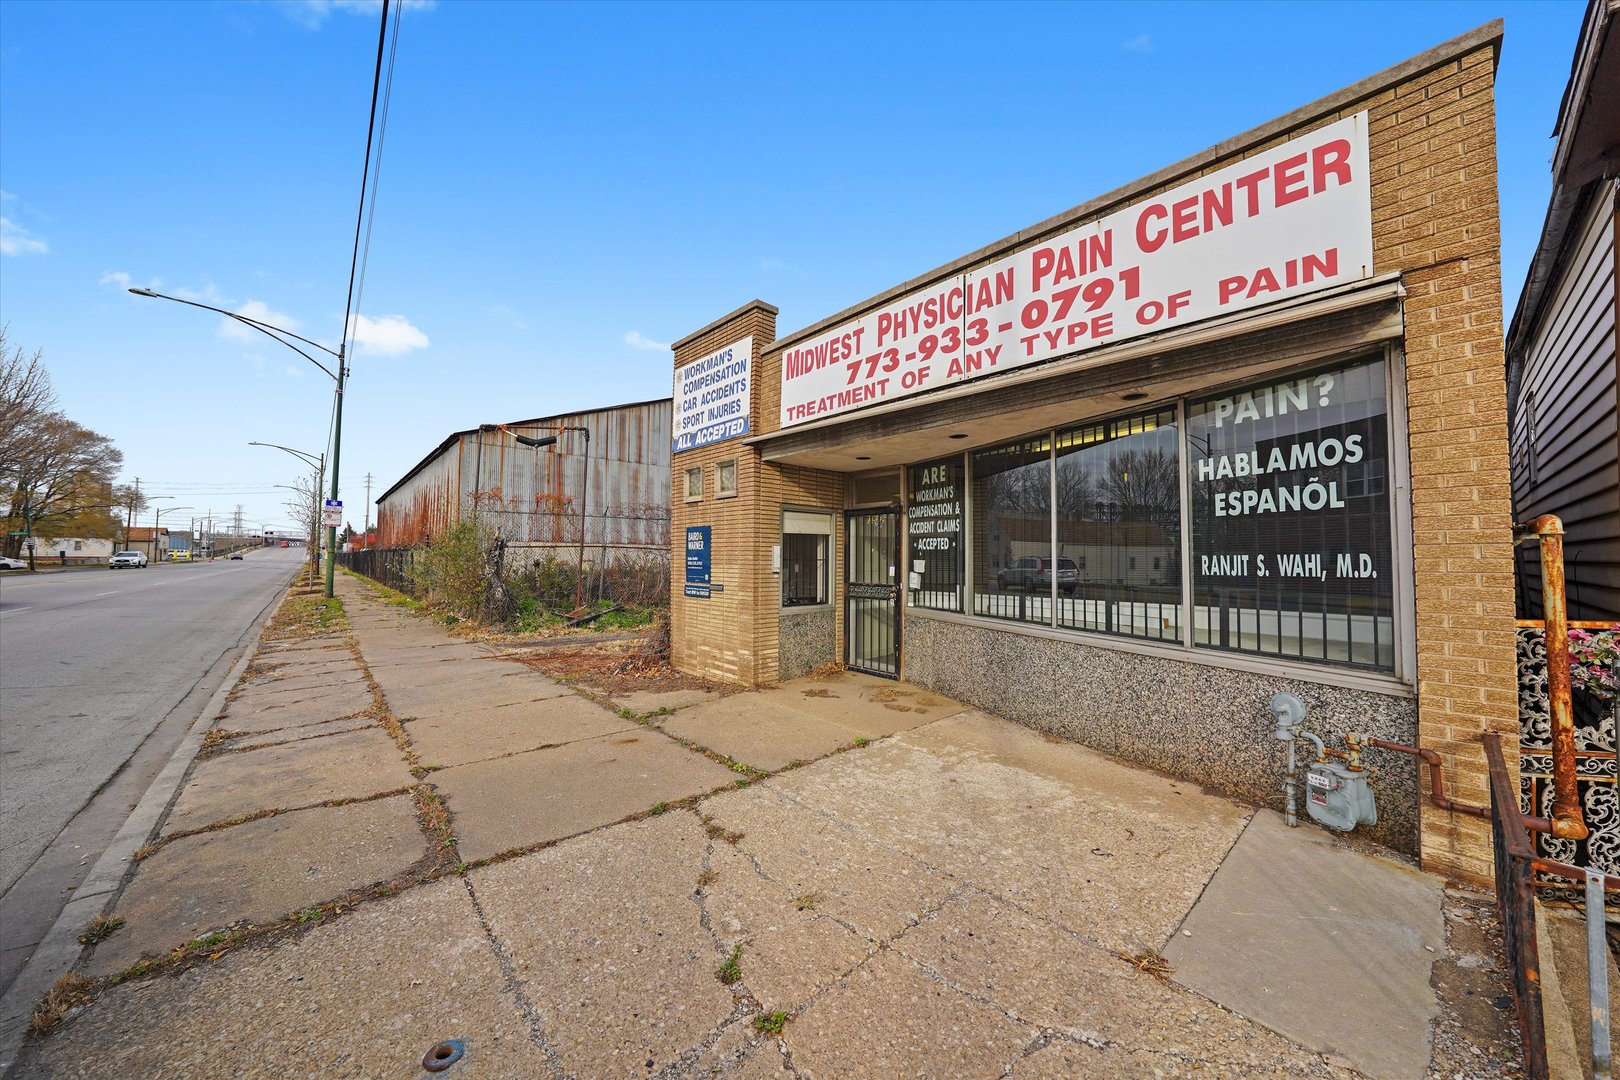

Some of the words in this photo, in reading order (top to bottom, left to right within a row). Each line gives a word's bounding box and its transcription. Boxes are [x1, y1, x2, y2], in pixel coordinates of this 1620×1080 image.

[785, 326, 865, 382] MIDWEST
[877, 267, 1014, 348] PHYSICIAN
[1032, 228, 1113, 293] PAIN
[1136, 138, 1353, 254] CENTER
[786, 378, 890, 422] TREATMENT
[901, 366, 931, 389] OF
[946, 344, 1003, 379] ANY
[1020, 312, 1114, 356] TYPE
[1136, 289, 1192, 326] OF
[1219, 247, 1339, 306] PAIN
[683, 348, 733, 381] WORKMAN'S
[683, 358, 747, 396] COMPENSATION
[682, 396, 697, 413] CAR
[700, 377, 747, 406] ACCIDENTS
[1214, 374, 1335, 429] PAIN?
[682, 411, 705, 430] SPORT
[707, 398, 742, 422] INJURIES
[677, 433, 693, 450] ALL
[695, 418, 745, 446] ACCEPTED
[1198, 434, 1364, 482] HABLAMOS
[921, 464, 946, 486] ARE
[908, 502, 953, 519] COMPENSATION
[955, 501, 961, 515] &
[915, 485, 954, 503] WORKMAN'S
[1214, 476, 1345, 517] ESPANÕL
[909, 521, 935, 534] ACCIDENT
[936, 518, 960, 533] CLAIMS
[917, 537, 949, 550] ACCEPTED
[1201, 554, 1249, 576] RANJIT
[1256, 554, 1270, 577] S.
[1277, 553, 1327, 582] WAHI,
[1336, 553, 1378, 579] M.D.
